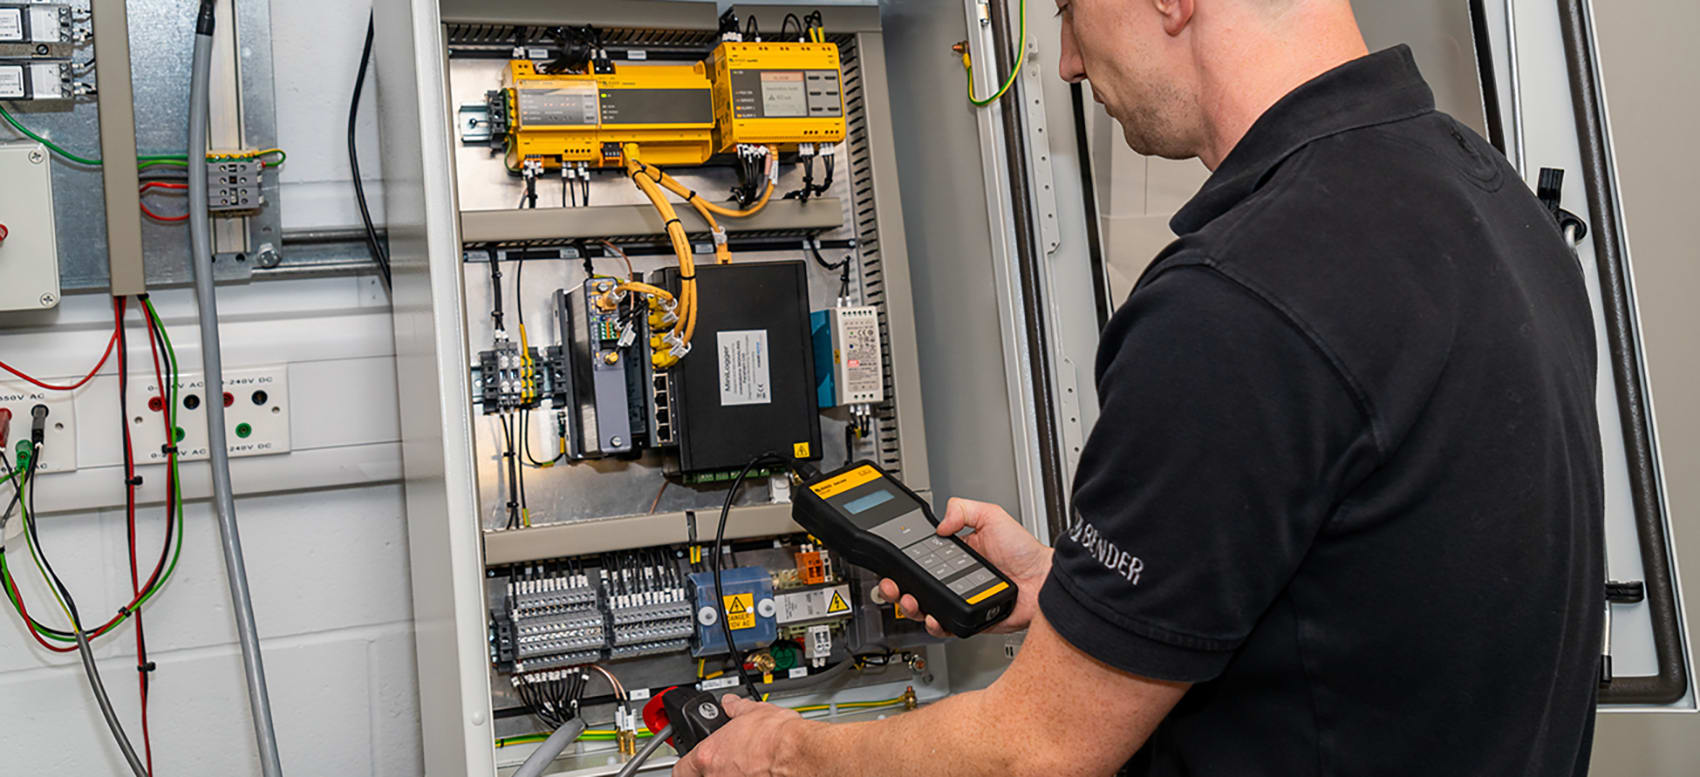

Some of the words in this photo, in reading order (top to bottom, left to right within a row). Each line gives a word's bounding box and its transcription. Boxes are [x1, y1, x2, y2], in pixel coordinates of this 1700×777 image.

[189, 381, 204, 389] AC
[30, 392, 45, 400] AC
[192, 448, 207, 456] AC
[1081, 523, 1144, 585] BENDER
[728, 613, 750, 622] ANGER
